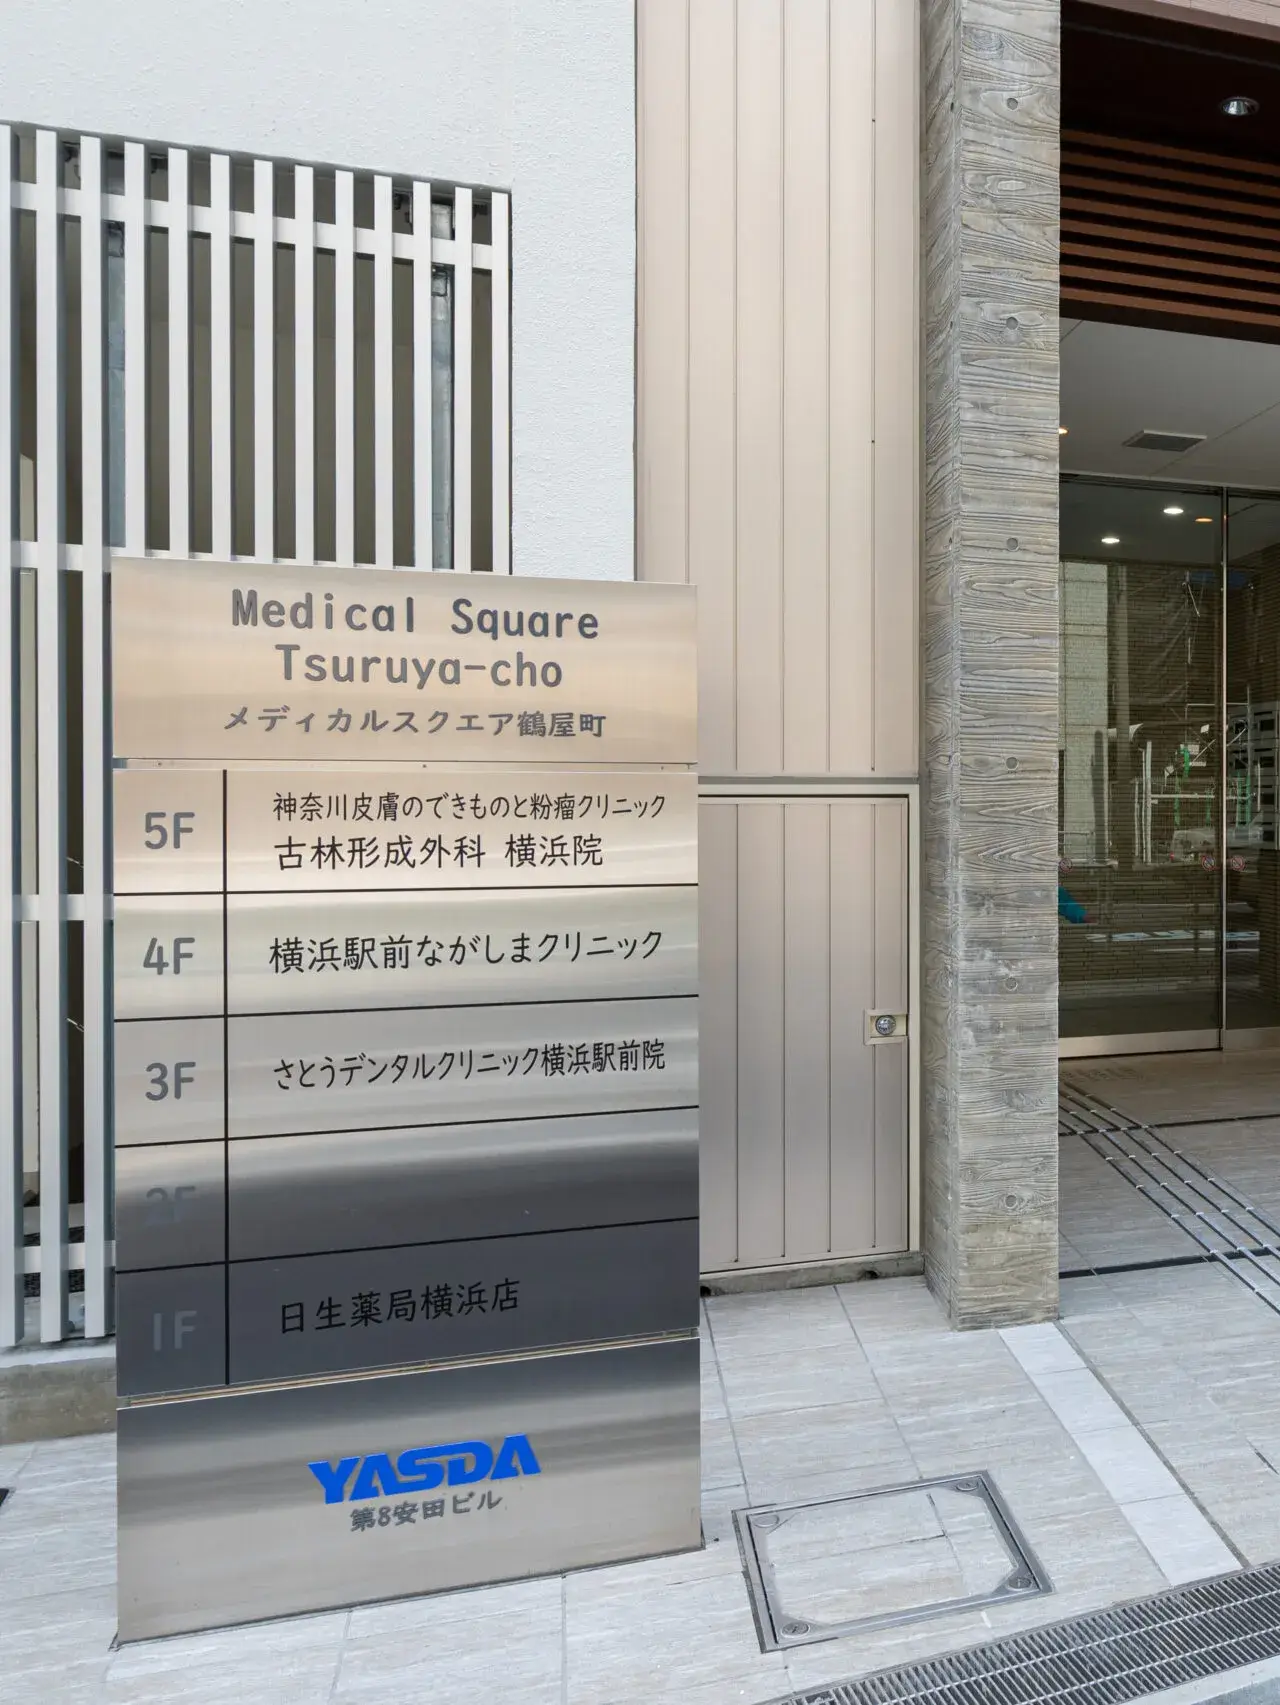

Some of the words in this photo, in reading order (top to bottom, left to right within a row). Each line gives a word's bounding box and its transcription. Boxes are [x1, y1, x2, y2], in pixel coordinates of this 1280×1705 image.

[231, 588, 415, 633] Medical
[451, 598, 599, 640] Square
[275, 643, 563, 690] Tsuruya-cho
[223, 705, 607, 739] メディカルスクエア鶴屋町
[272, 791, 666, 822] 神奈川皮膚のできものと粉瘤クリニック
[143, 811, 195, 849] 5F
[273, 834, 487, 871] 古林形成外科
[504, 833, 604, 868] 横浜院
[142, 936, 195, 976] 4F
[268, 930, 663, 976] 横浜駅前ながしまクリニック
[144, 1062, 196, 1101] 3F
[273, 1037, 666, 1091] さとうデンタルクリニック横浜駅前院
[280, 1278, 521, 1335] 日生薬局横浜店
[153, 1310, 197, 1351] 1F
[307, 1433, 542, 1505] YASDA
[349, 1490, 503, 1532] 第8安田ビル
